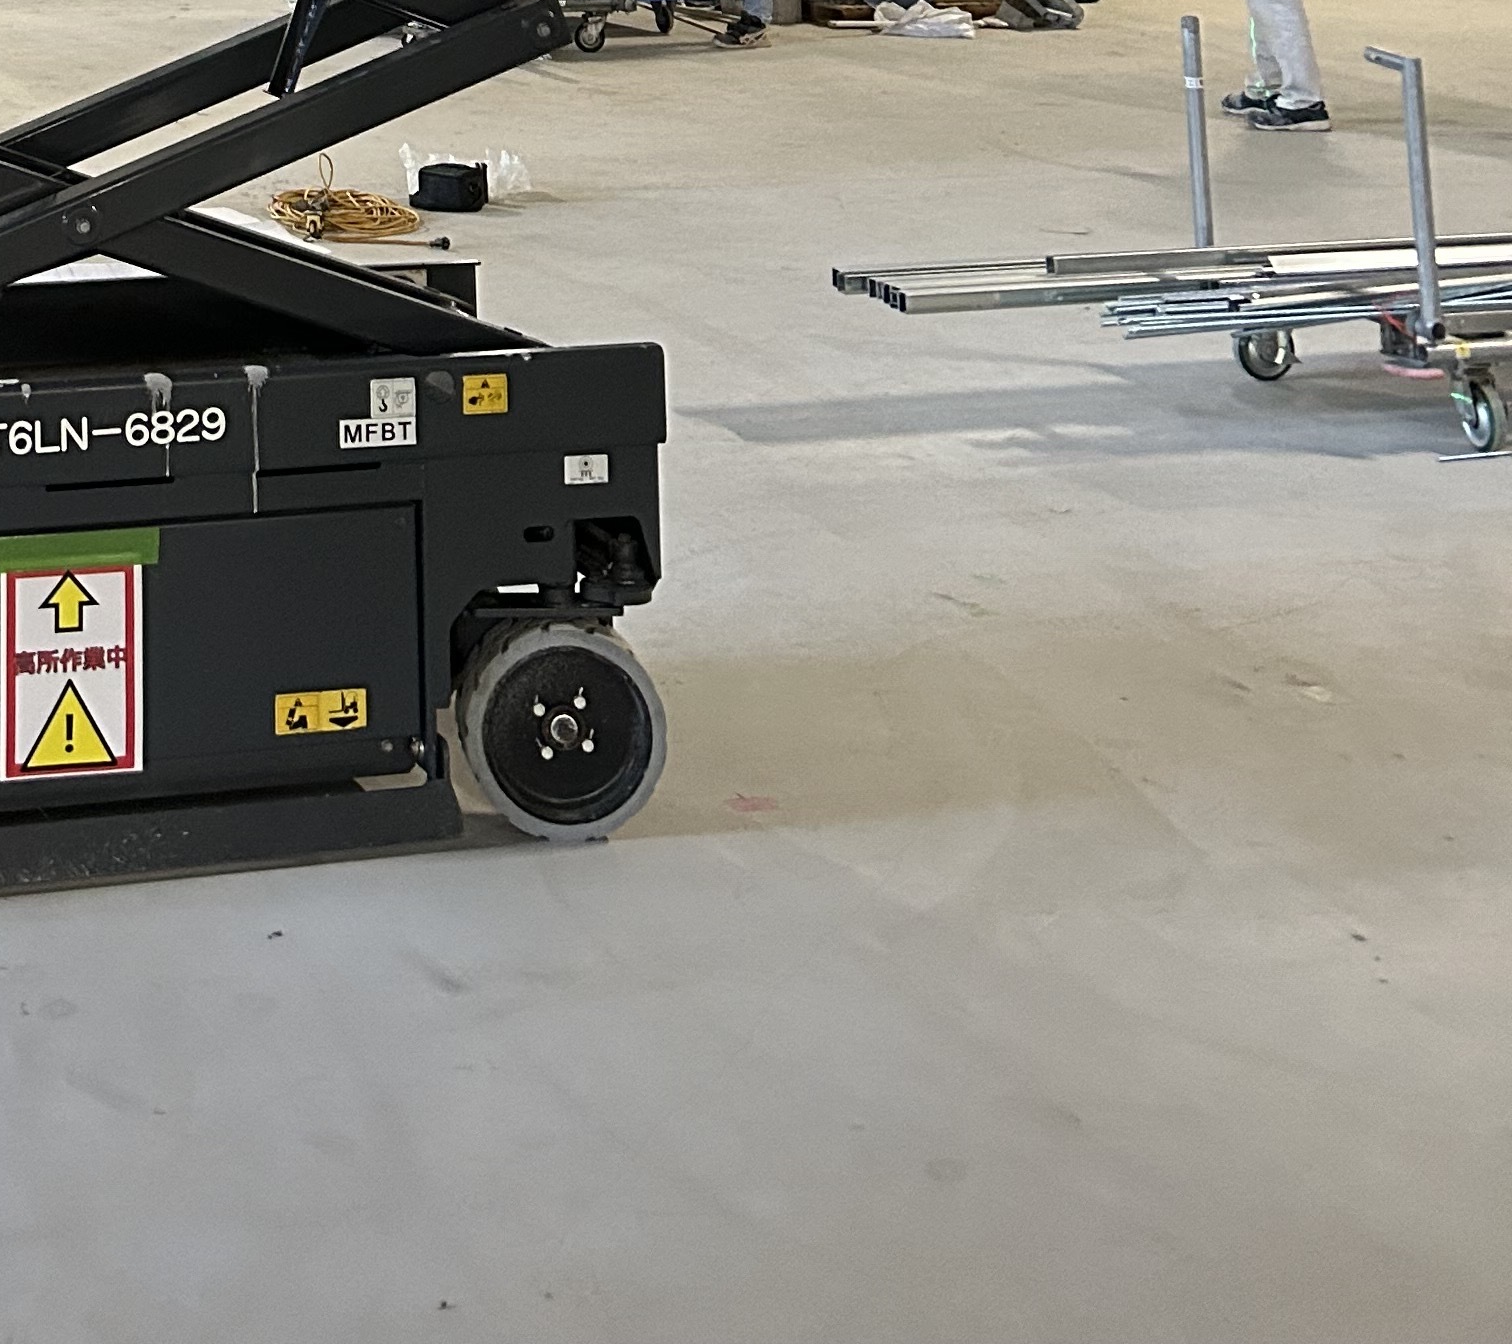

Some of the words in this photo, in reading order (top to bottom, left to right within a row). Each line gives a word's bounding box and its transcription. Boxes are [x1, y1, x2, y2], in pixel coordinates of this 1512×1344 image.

[343, 421, 412, 444] MFBT
[15, 644, 127, 675] 高所作業中
